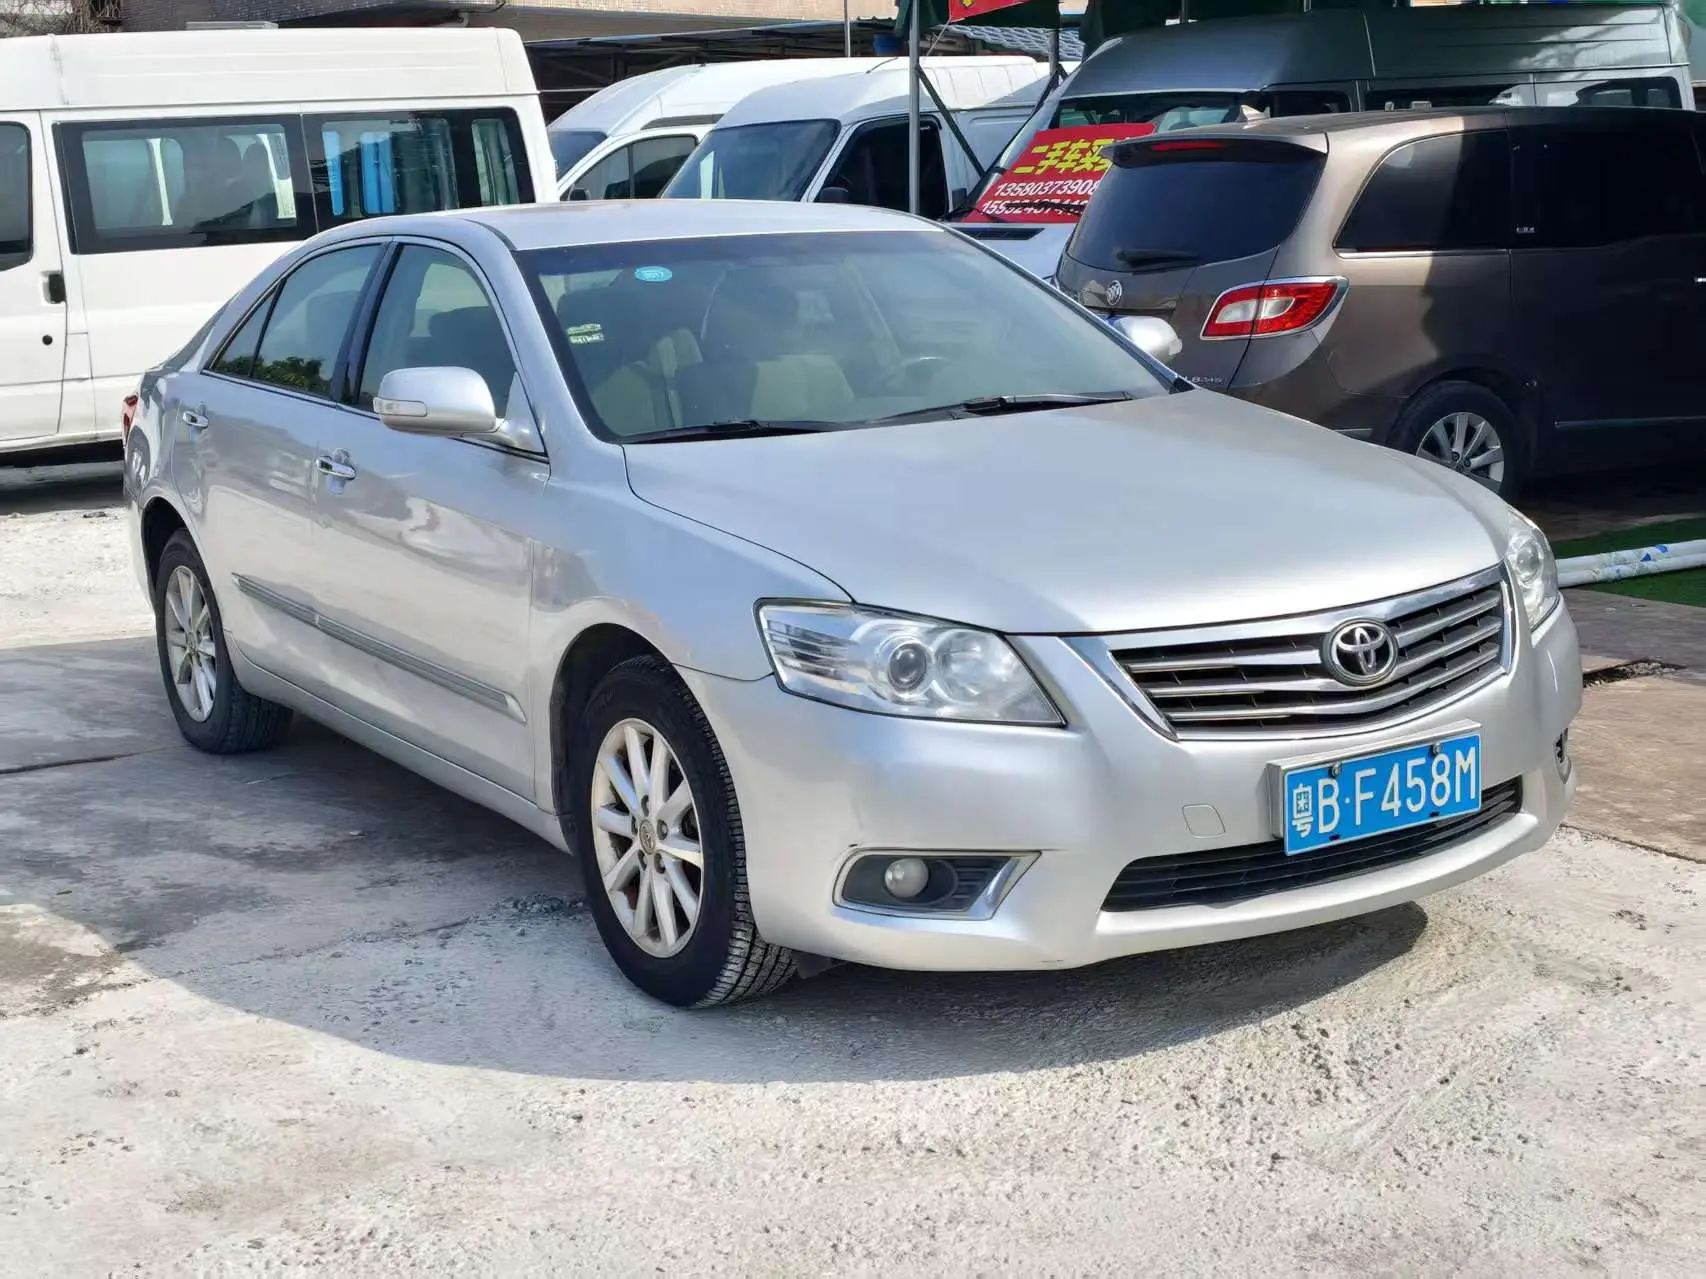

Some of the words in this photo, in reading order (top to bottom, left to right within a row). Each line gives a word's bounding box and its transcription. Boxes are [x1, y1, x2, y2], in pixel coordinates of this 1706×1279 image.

[1013, 138, 1113, 175] 二手车买
[1291, 745, 1476, 838] 粤B·F458M
